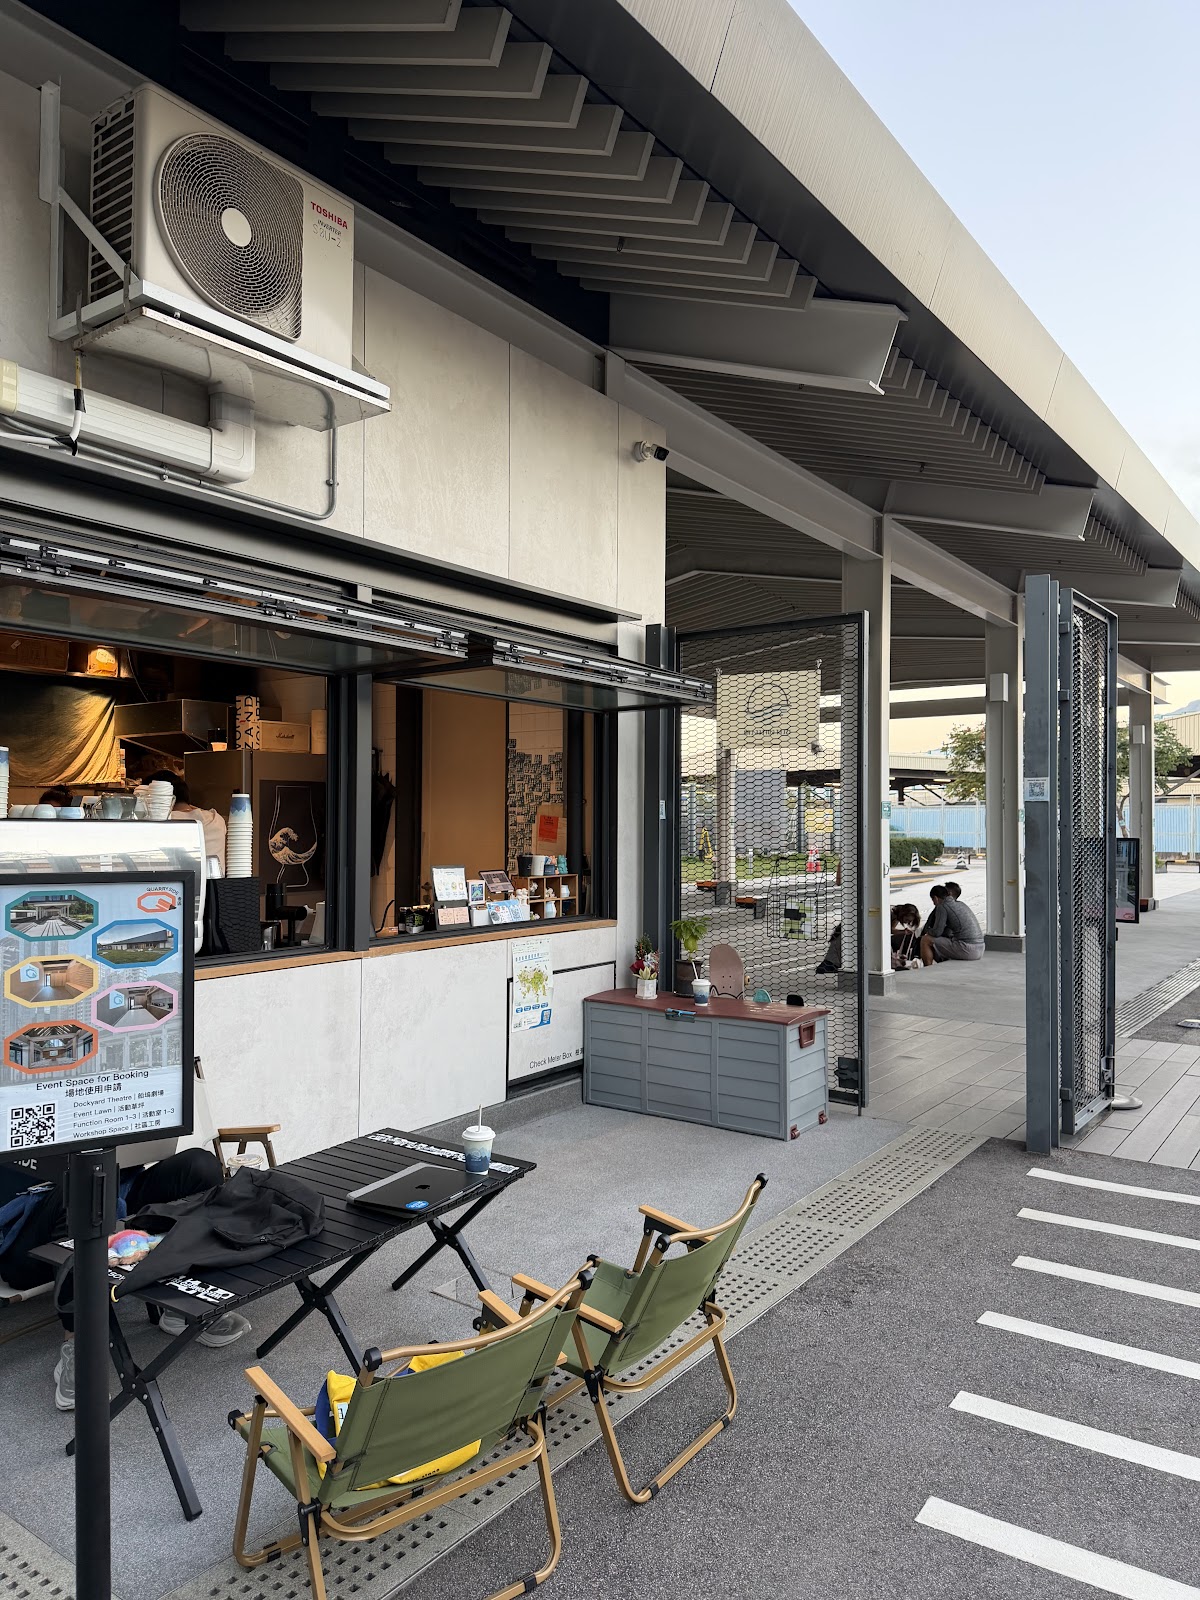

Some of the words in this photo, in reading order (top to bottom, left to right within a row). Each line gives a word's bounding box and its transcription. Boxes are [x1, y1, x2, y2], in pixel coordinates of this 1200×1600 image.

[311, 201, 348, 229] TOSHIBA
[317, 219, 342, 236] INVERTER
[529, 1058, 547, 1069] Check
[562, 1051, 573, 1060] Box
[36, 1081, 62, 1091] Event
[65, 1078, 94, 1088] Space
[113, 1070, 149, 1080] Booking
[65, 1082, 122, 1098] 場地使用申請
[73, 1098, 106, 1108] Dockyard
[107, 1095, 133, 1103] Theatre
[73, 1110, 92, 1119] Event
[73, 1118, 103, 1128] Function
[104, 1116, 124, 1124] Room
[73, 1128, 107, 1139] Workshop
[108, 1126, 129, 1134] Space
